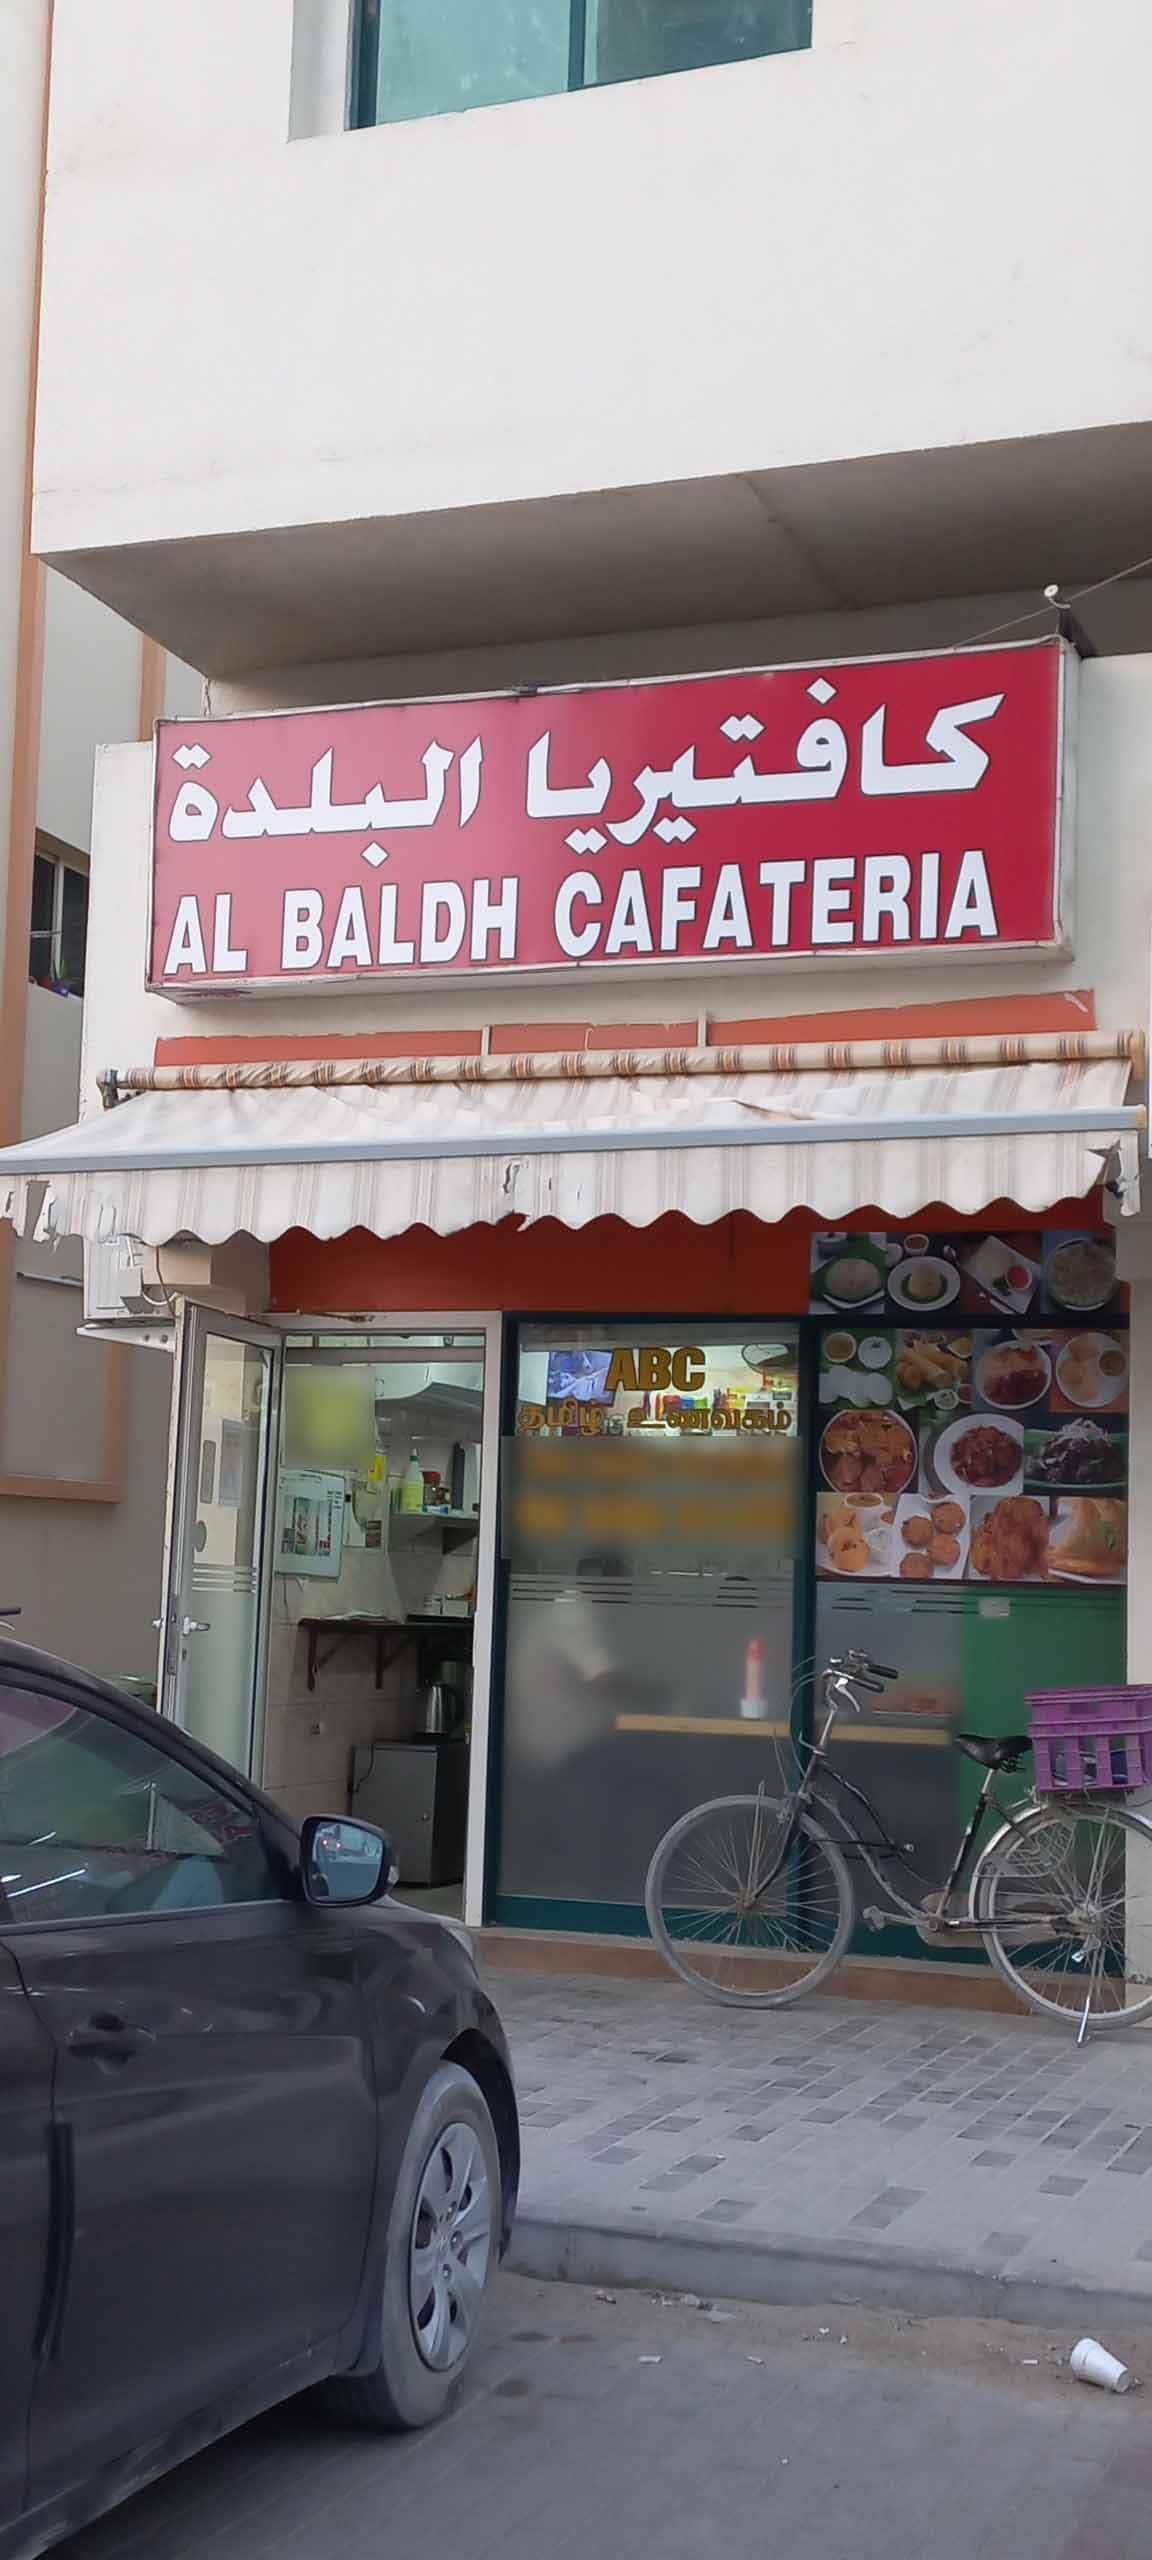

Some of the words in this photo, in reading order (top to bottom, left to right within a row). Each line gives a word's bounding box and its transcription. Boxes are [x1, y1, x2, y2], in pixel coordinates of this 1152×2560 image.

[167, 735, 483, 868] البلدة
[525, 676, 1006, 855] كافتيريا
[162, 892, 248, 975] AL
[280, 876, 519, 970] BALDH
[553, 849, 999, 958] CAFATERIA
[604, 1347, 706, 1391] ABC
